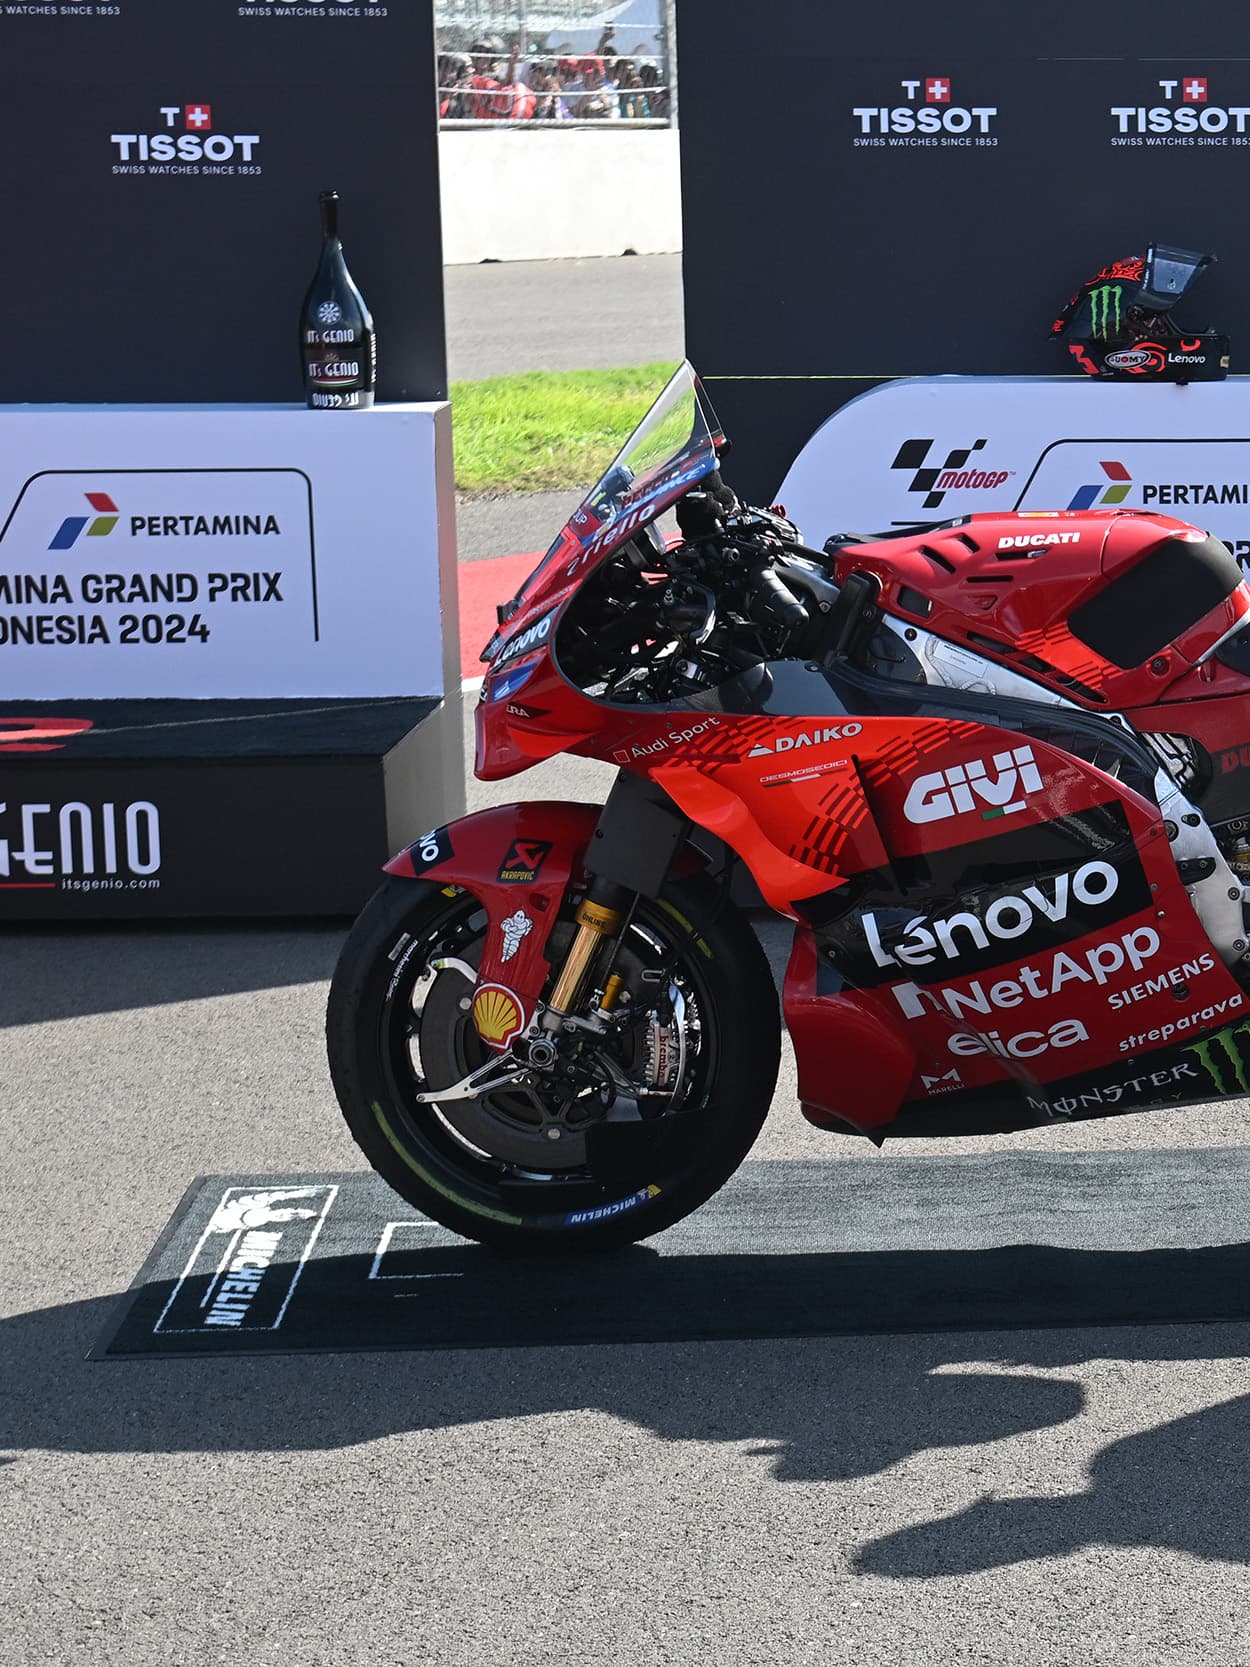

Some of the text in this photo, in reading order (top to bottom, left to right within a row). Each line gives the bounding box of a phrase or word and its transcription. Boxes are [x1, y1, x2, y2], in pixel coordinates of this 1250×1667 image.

[6, 6, 120, 15] WATCHES SINCE 1853
[238, 7, 388, 16] SWISS WATCHES SINCE 1853
[853, 107, 997, 133] TISSOT
[111, 134, 260, 161] TISSOT
[854, 137, 998, 147] SWISS WATCHES SINCE 1853
[1111, 137, 1143, 146] SWISS
[1146, 137, 1195, 146] WATCHES
[1197, 137, 1228, 146] SINCE
[112, 165, 262, 174] SWISS WATCHES SINCE 1853
[322, 329, 354, 343] GENIO
[325, 362, 359, 376] GENIO
[1168, 353, 1206, 364] Lenovo
[131, 515, 280, 536] PERTAMINA
[582, 504, 655, 564] riello
[998, 532, 1080, 548] DUCATI
[82, 574, 198, 603] GRAND
[208, 572, 284, 602] PRIX
[119, 614, 210, 644] 2024
[492, 618, 550, 666] Lenovo
[632, 716, 720, 758] Audi Sport
[775, 722, 862, 752] DAIKO
[760, 760, 847, 782] DESMOSEDICI
[904, 745, 1044, 824] GIVI
[62, 878, 160, 892] itsgenio.com
[861, 860, 1119, 967] Lenovo
[943, 926, 1161, 1019] NetApp
[1107, 953, 1215, 1011] SIEMENS
[1119, 994, 1243, 1052] streparava
[947, 1018, 1090, 1058] elica
[659, 1036, 668, 1078] brembo
[928, 1083, 965, 1095] MARELLI
[1027, 1063, 1199, 1117] MONSTER
[571, 1196, 636, 1223] MICHELIN
[204, 1231, 283, 1327] MICHELIN
